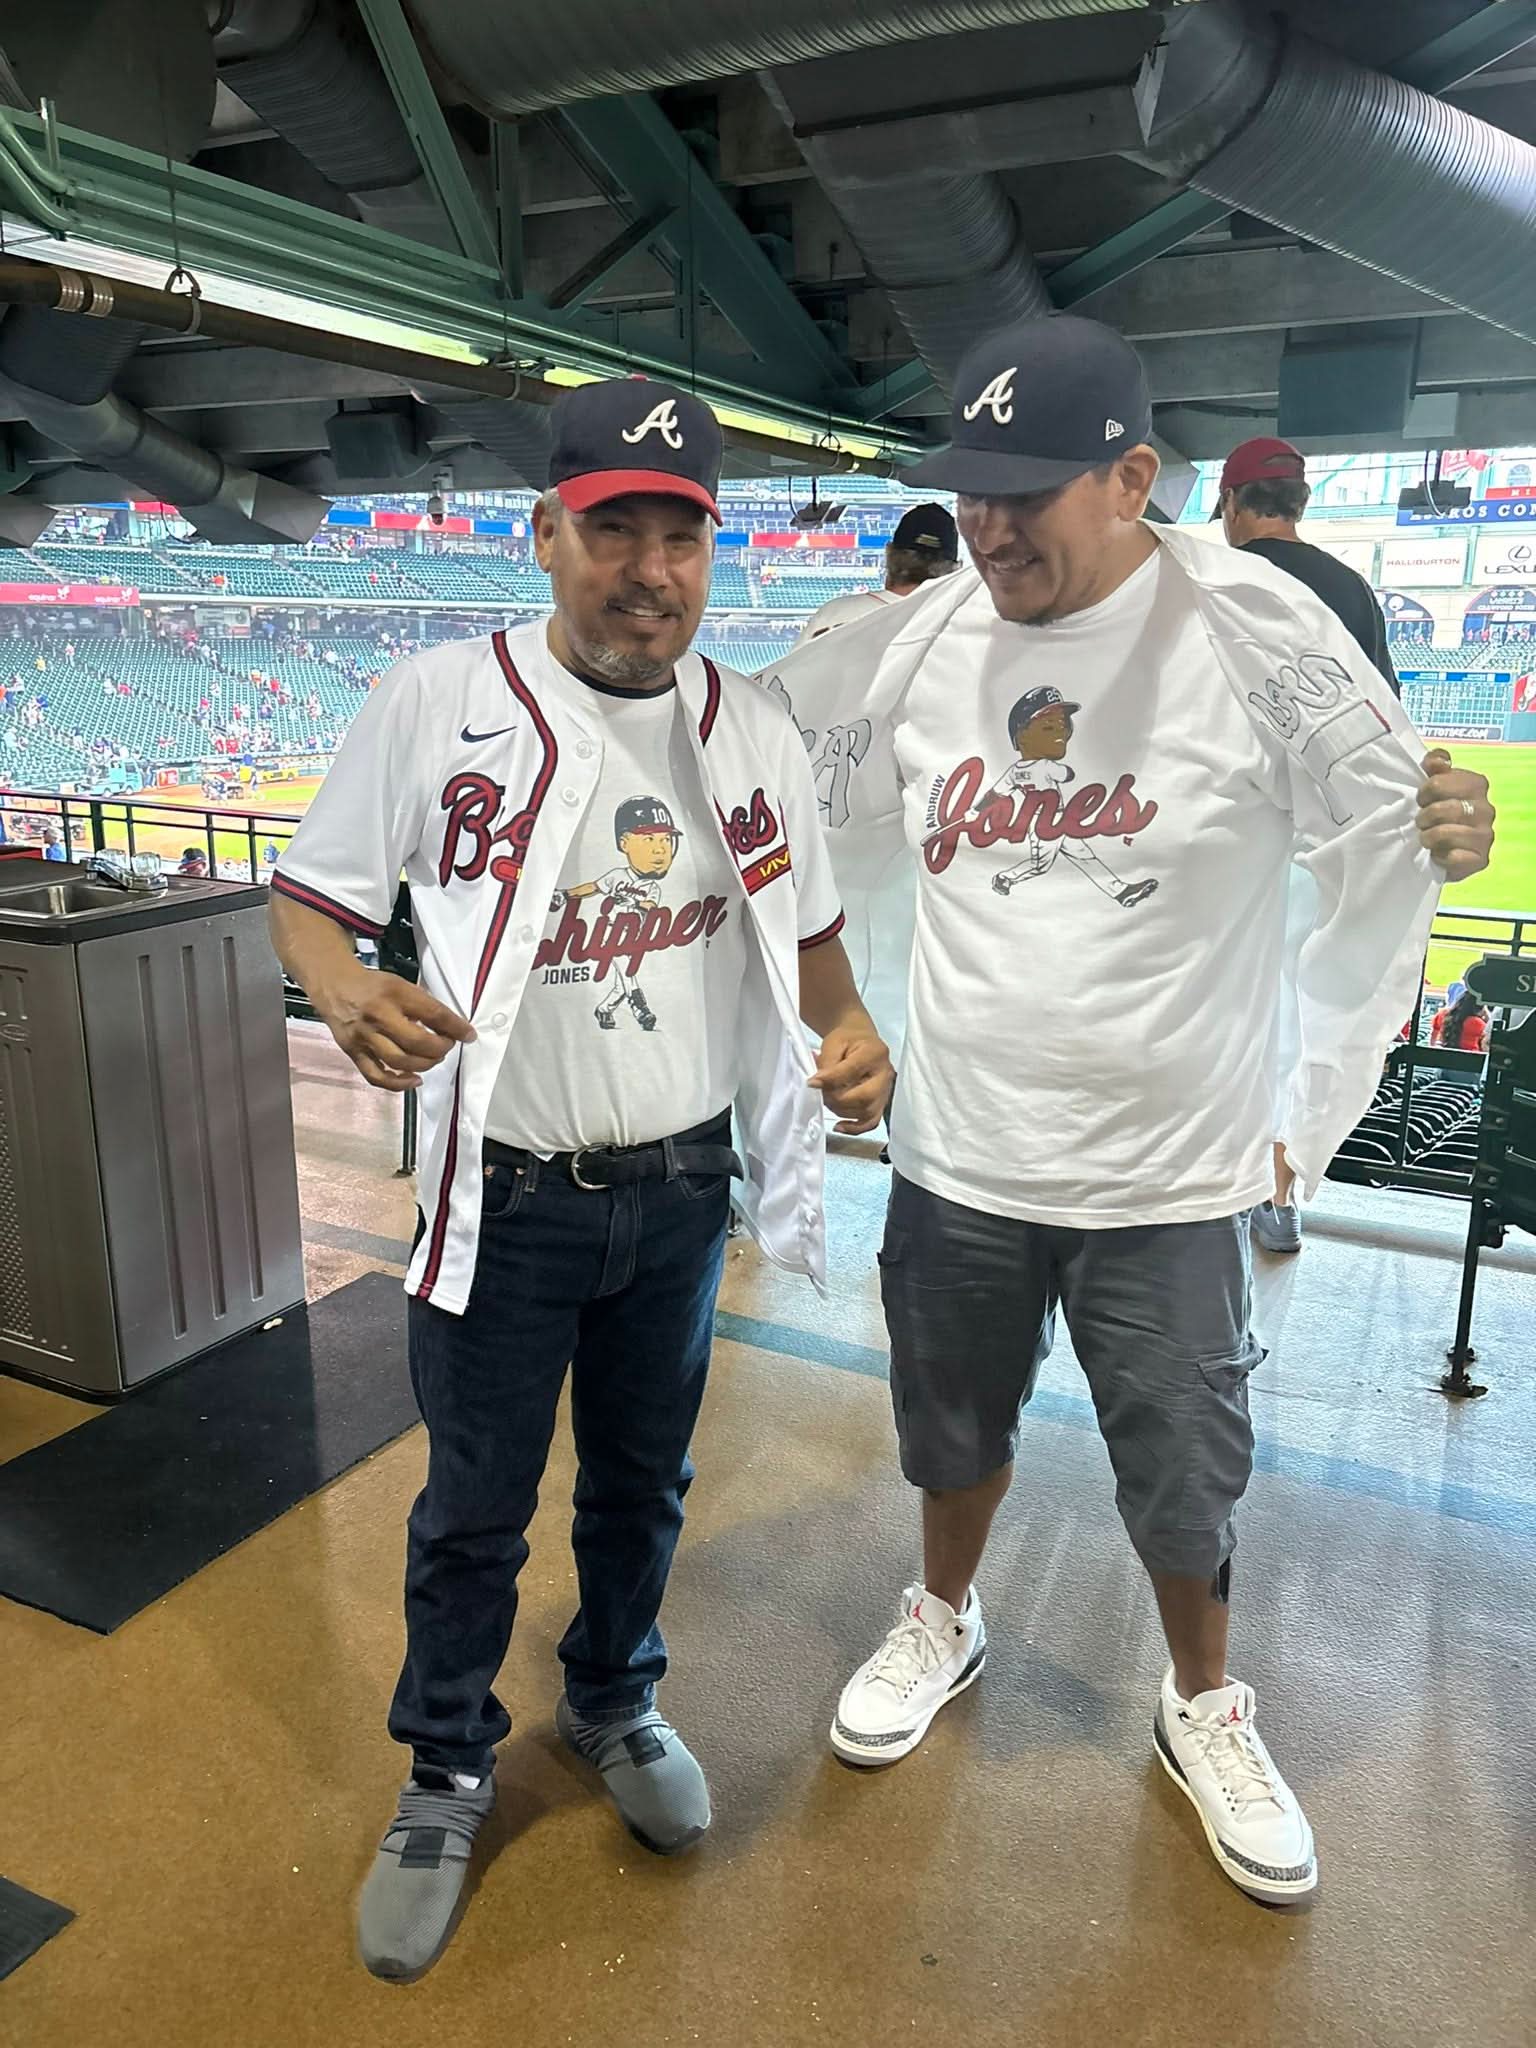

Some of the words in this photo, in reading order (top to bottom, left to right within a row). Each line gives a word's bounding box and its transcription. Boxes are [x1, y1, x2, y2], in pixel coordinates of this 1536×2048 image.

[963, 367, 1018, 424] A
[621, 399, 684, 450] A
[651, 808, 667, 824] 10
[923, 756, 1159, 875] Jones
[926, 774, 946, 829] ANDRUW
[542, 967, 591, 985] JONES
